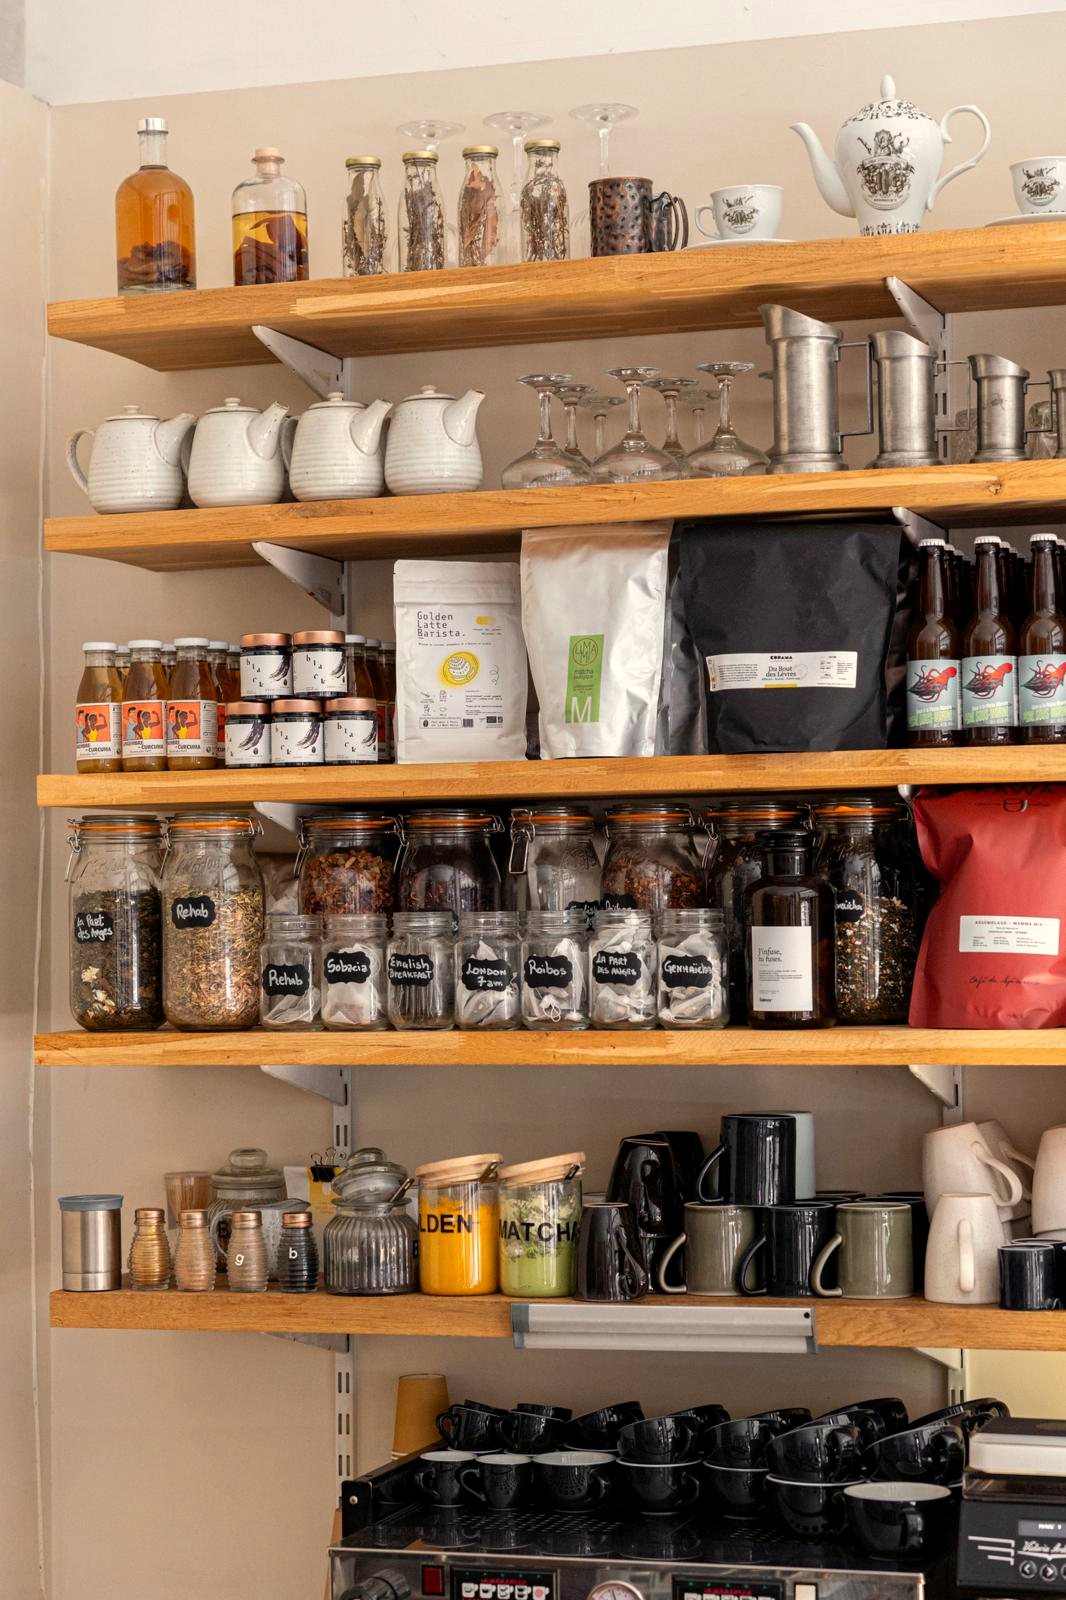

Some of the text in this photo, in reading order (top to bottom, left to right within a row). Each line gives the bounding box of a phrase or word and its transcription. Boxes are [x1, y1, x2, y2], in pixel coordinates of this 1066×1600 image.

[417, 610, 453, 621] Golden
[417, 620, 448, 629] Latte
[417, 628, 466, 638] Barista.
[571, 695, 593, 722] M
[177, 904, 209, 920] Rehab
[595, 952, 606, 964] LA
[528, 959, 567, 976] Roibos
[268, 969, 304, 987] Rehab
[234, 1253, 245, 1266] g
[288, 1247, 298, 1260] b
